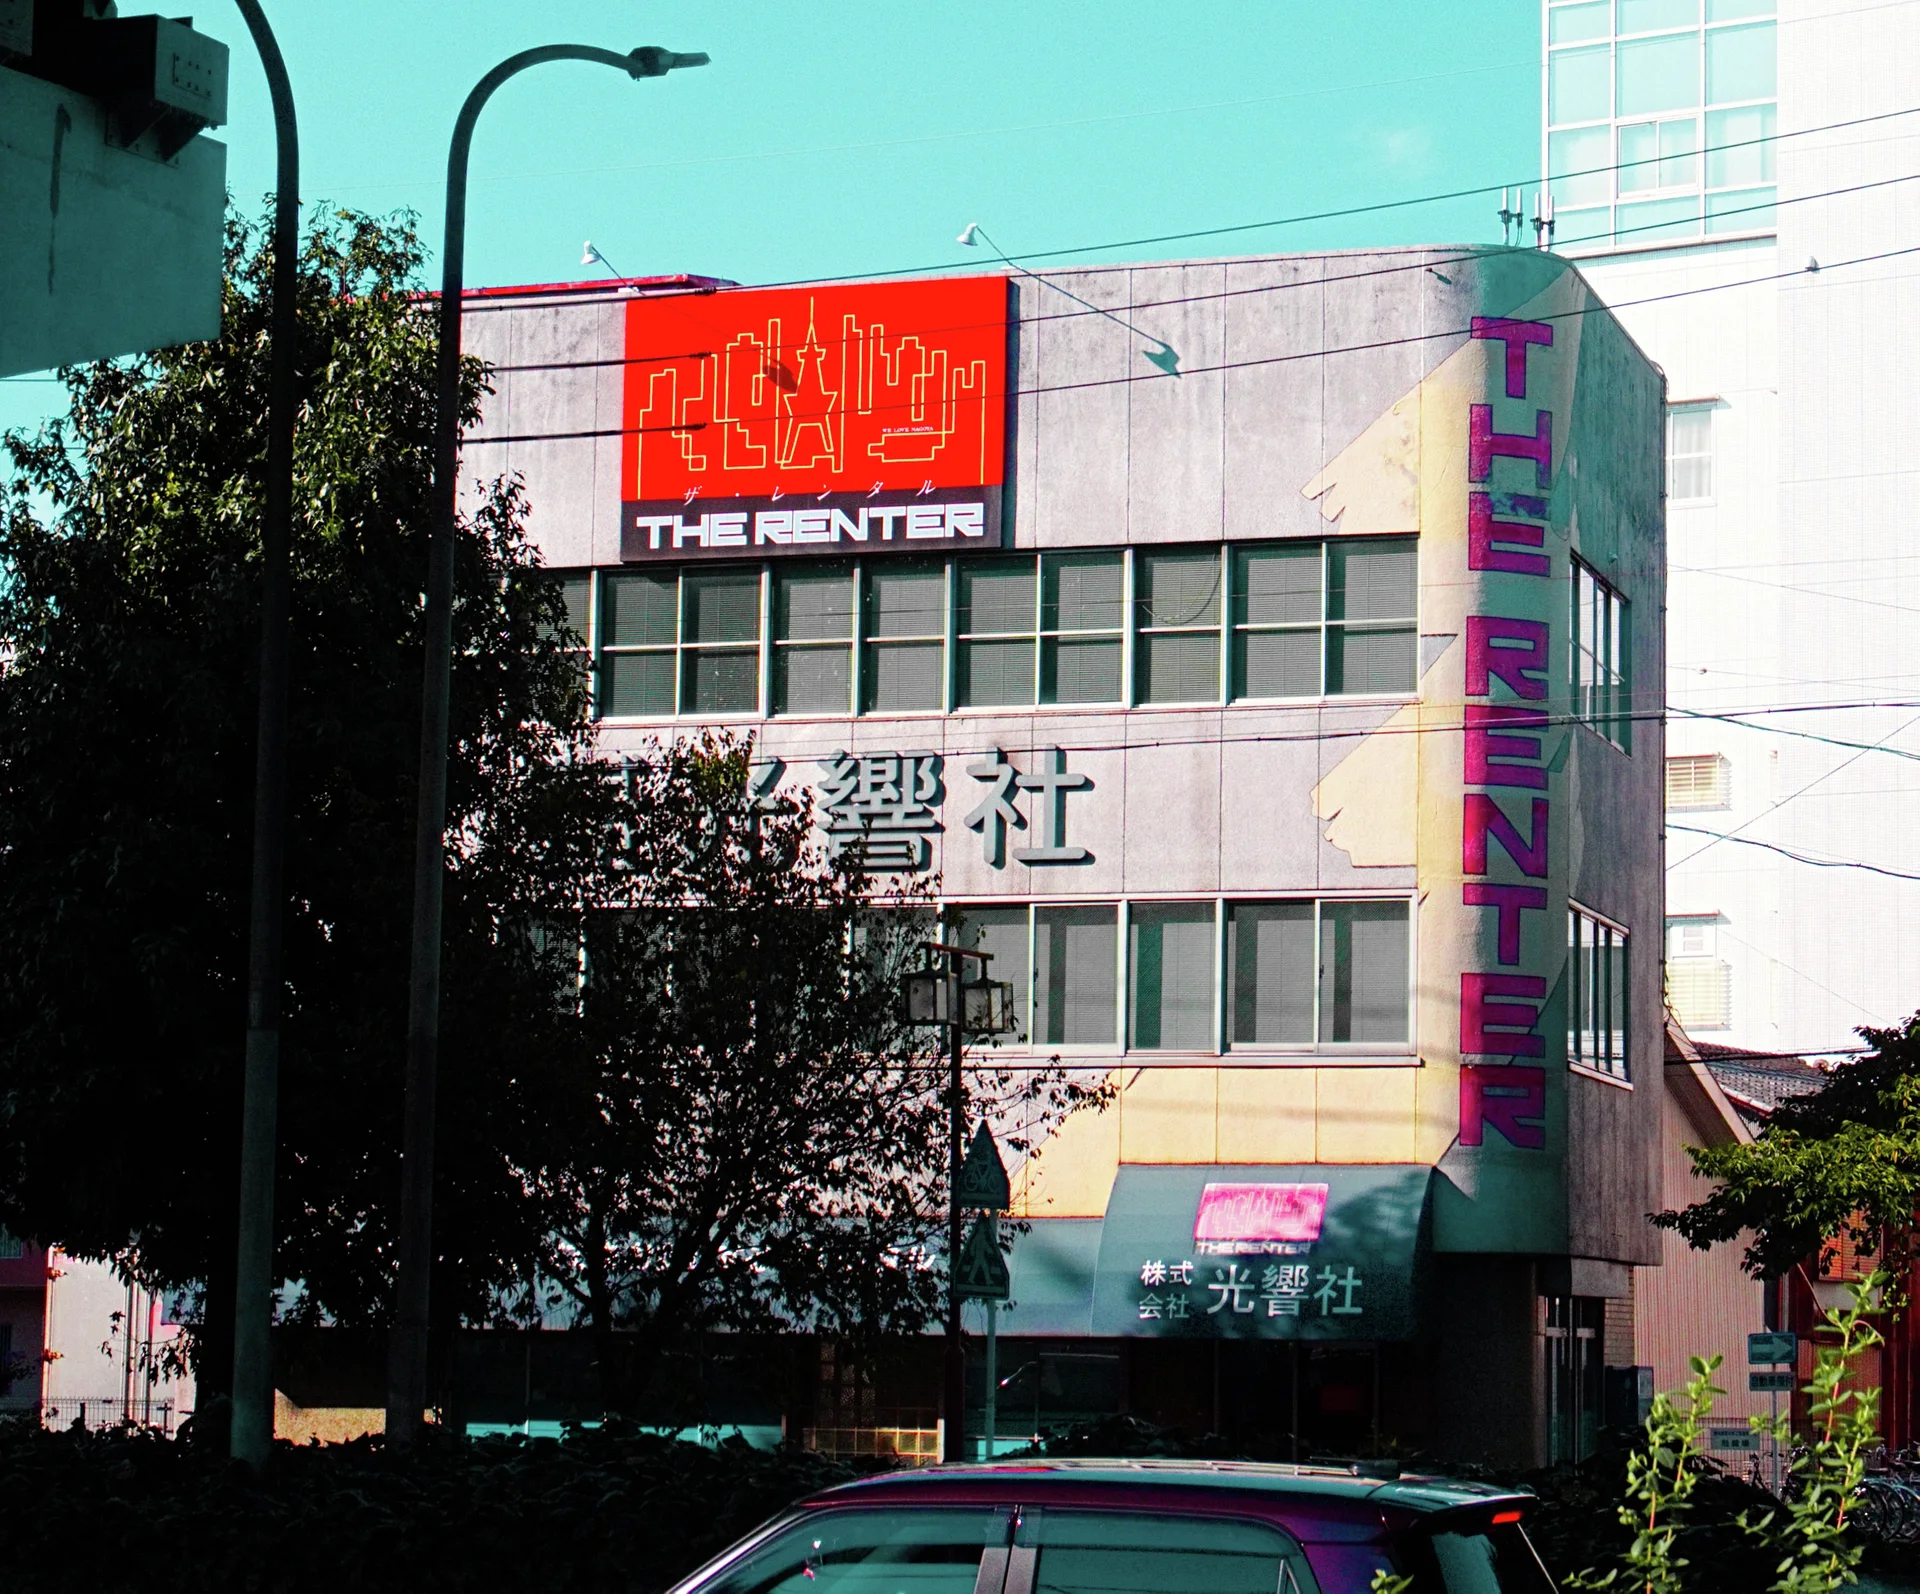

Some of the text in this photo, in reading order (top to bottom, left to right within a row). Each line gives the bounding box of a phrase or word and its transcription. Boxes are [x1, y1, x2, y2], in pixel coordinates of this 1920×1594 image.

[636, 502, 984, 549] THE RENTER
[1459, 316, 1554, 1150] THE RENTER
[1196, 1240, 1312, 1256] THE RENTER
[1140, 1260, 1194, 1287] 株式
[1206, 1264, 1363, 1317] 光響社
[1139, 1293, 1190, 1320] 会社
